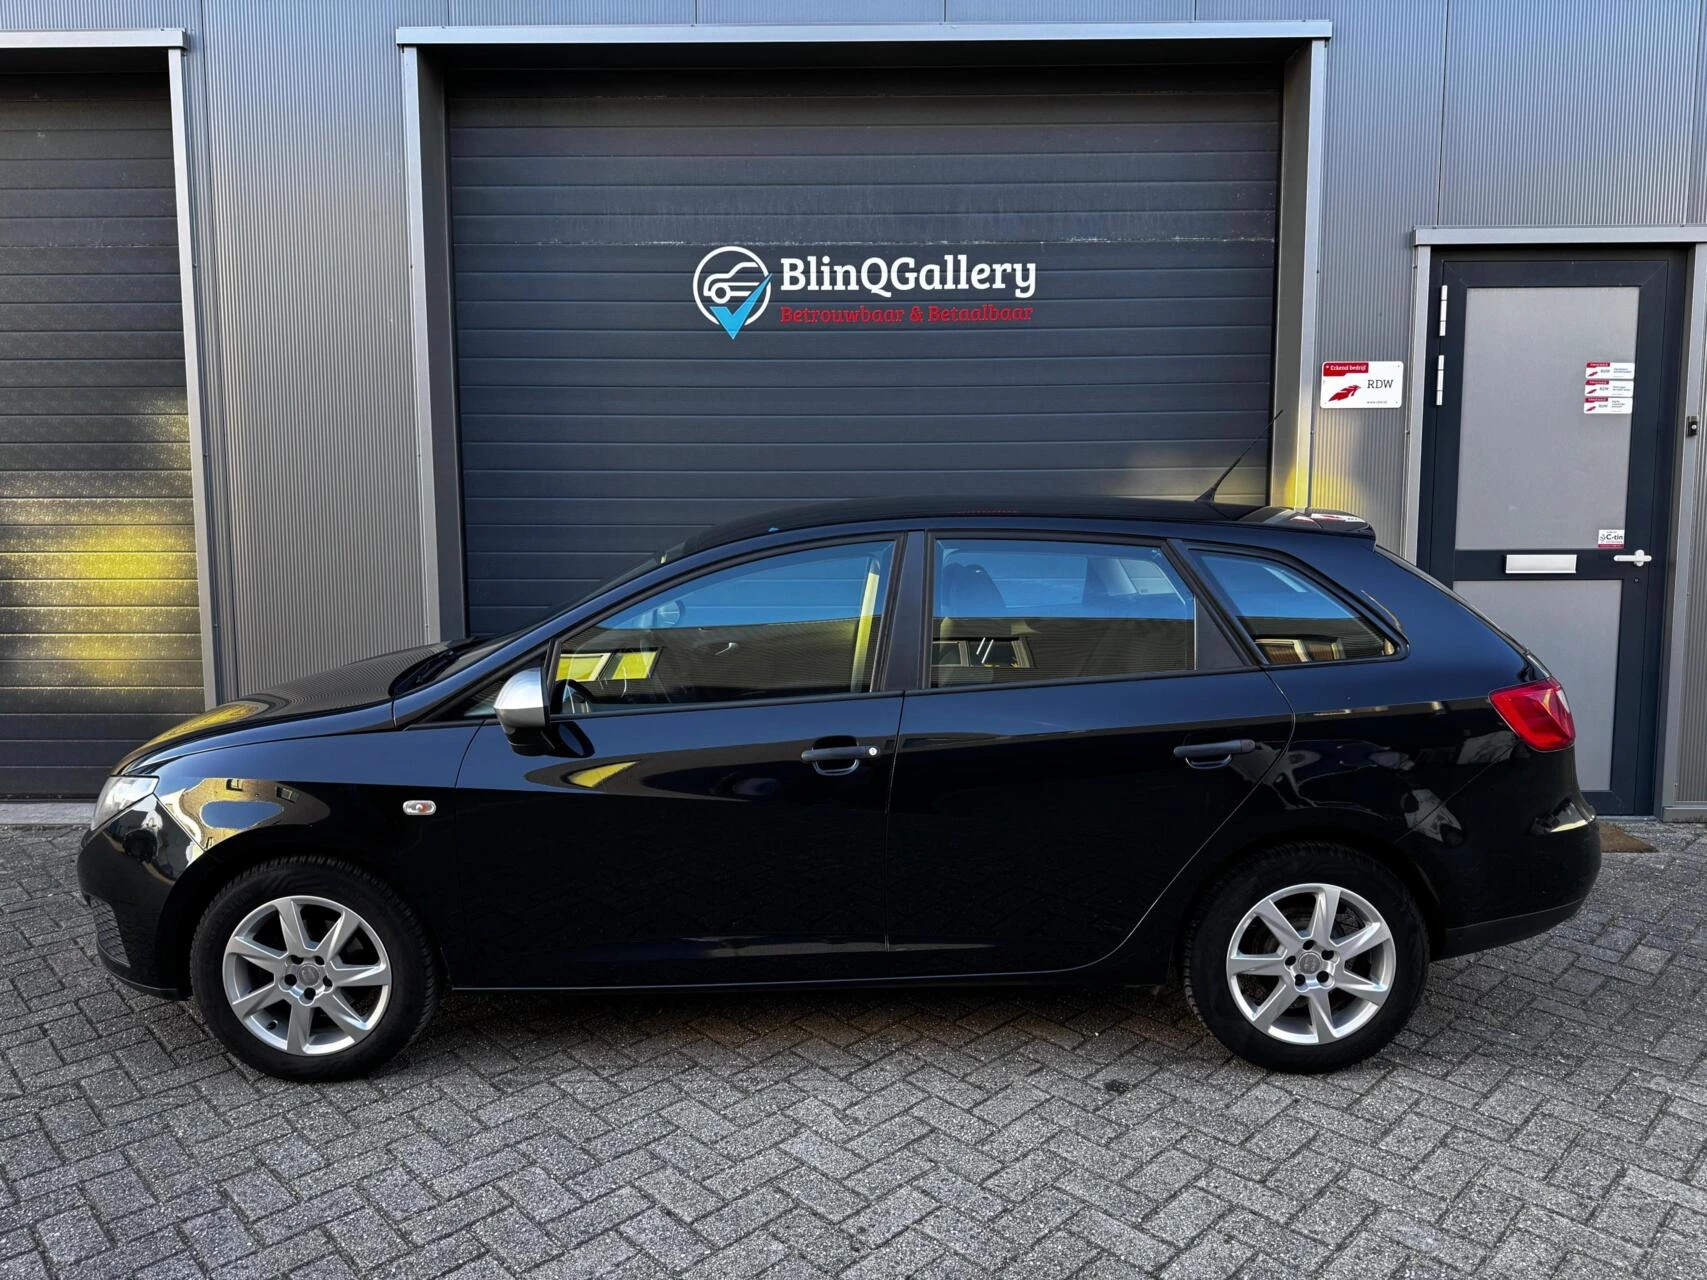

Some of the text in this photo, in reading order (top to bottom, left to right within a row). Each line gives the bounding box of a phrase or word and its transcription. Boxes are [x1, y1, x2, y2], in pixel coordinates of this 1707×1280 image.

[780, 254, 1036, 298] BlinQGallery
[780, 304, 1034, 323] Betrouwbaar & Betaalbaar
[1367, 379, 1394, 389] RDW
